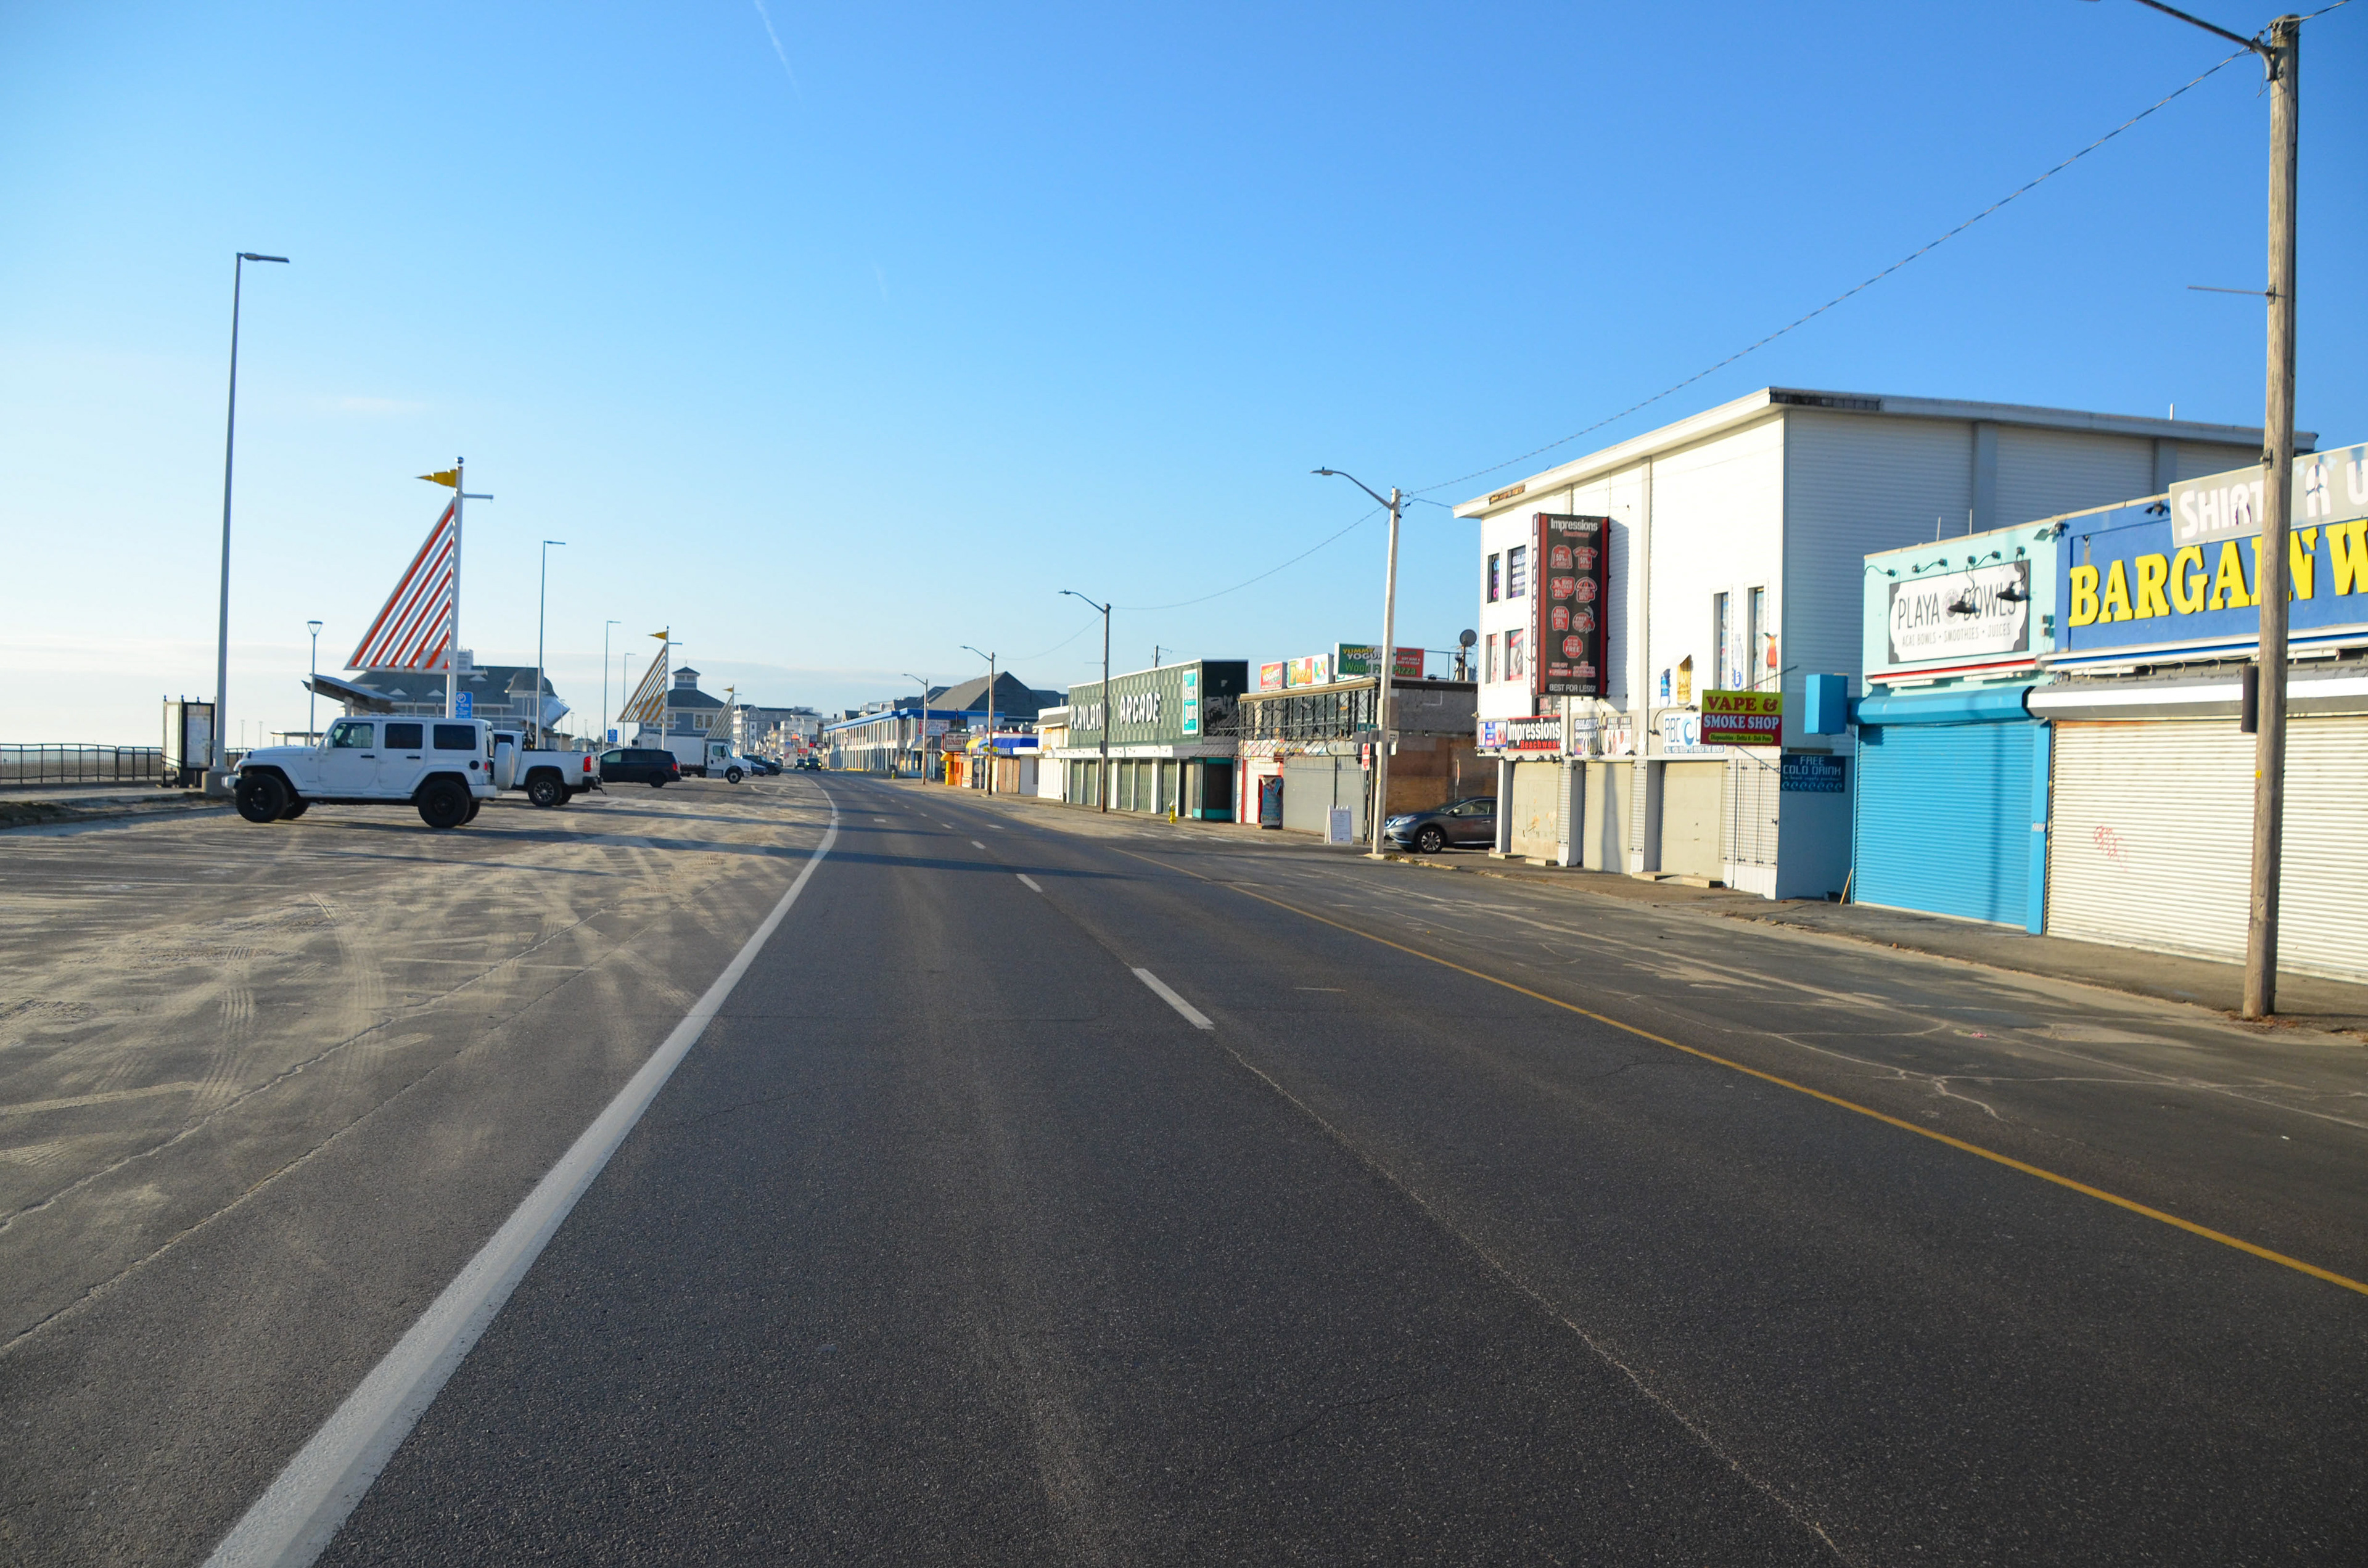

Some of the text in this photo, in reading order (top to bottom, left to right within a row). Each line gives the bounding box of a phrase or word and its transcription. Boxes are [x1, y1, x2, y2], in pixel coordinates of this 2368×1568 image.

[2306, 464, 2331, 517] R
[1550, 518, 1598, 532] Impressions
[1897, 593, 1940, 630] PLAYA
[1917, 631, 1936, 646] BOWLS
[1944, 626, 1979, 642] SMOOTHIES
[1988, 623, 2011, 638] JUICES
[1346, 662, 1370, 673] Wood
[1392, 665, 1416, 675] Pizza
[1566, 684, 1578, 692] FOR
[1069, 691, 1160, 731] PLAYLAN ARCADE
[1706, 696, 1778, 712] VAPE &
[1665, 717, 1680, 743] ABC
[1703, 714, 1780, 730] SMOKE SHOP
[1508, 718, 1561, 746] Impressions
[1520, 739, 1560, 749] Beachwear
[1800, 756, 1825, 765] FREE
[1783, 765, 1841, 776] COLD DRINK
